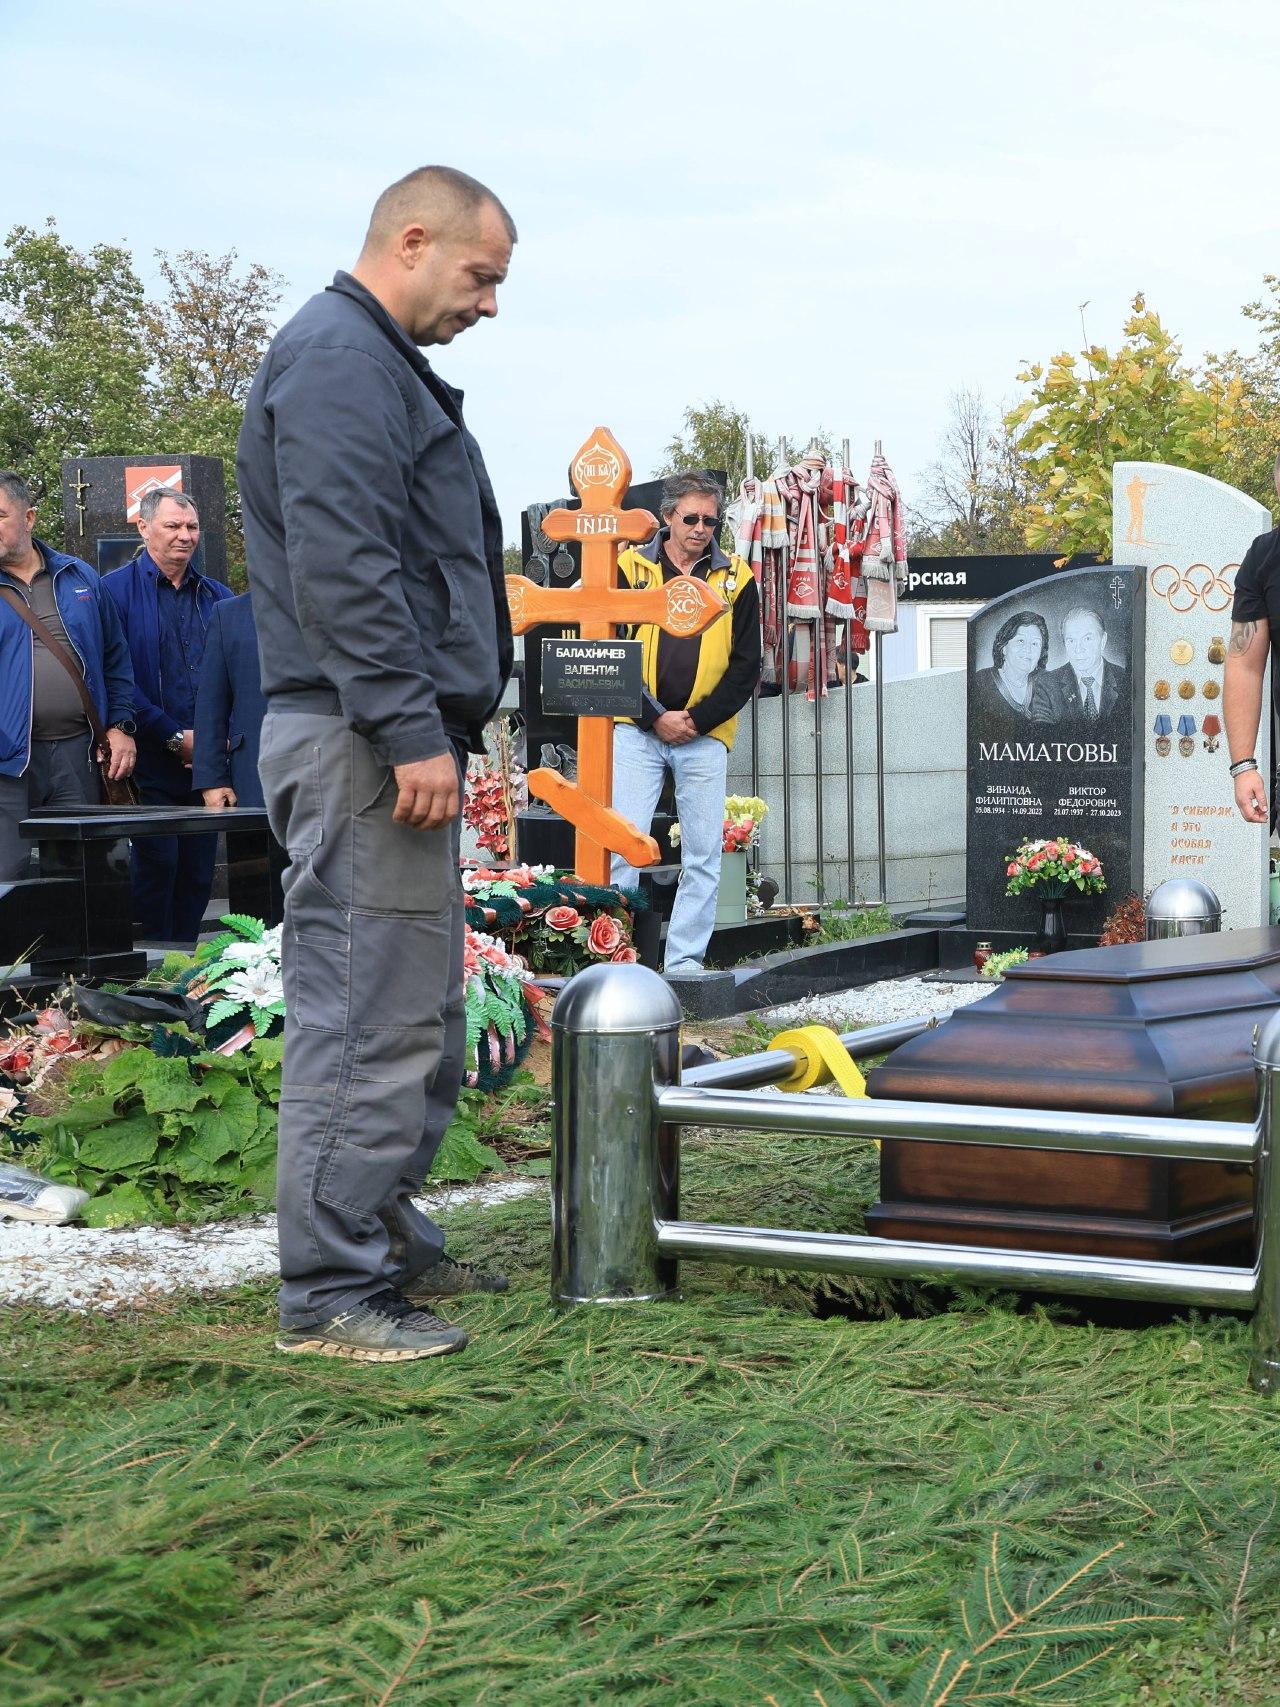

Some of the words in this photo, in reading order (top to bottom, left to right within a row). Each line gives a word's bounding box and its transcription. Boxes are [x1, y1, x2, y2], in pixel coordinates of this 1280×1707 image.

[556, 647, 626, 659] БАЛАХНИЧЕВ
[564, 664, 619, 675] ВАЛЕНТИН
[979, 742, 1118, 763] МАМАТОВЫ
[986, 785, 1031, 795] ЗИНАИДА
[1068, 786, 1107, 796] ВИКТОР
[975, 796, 1043, 806] ФИЛИППОВНА
[1058, 798, 1117, 808] ФЕДОРОВИЧ
